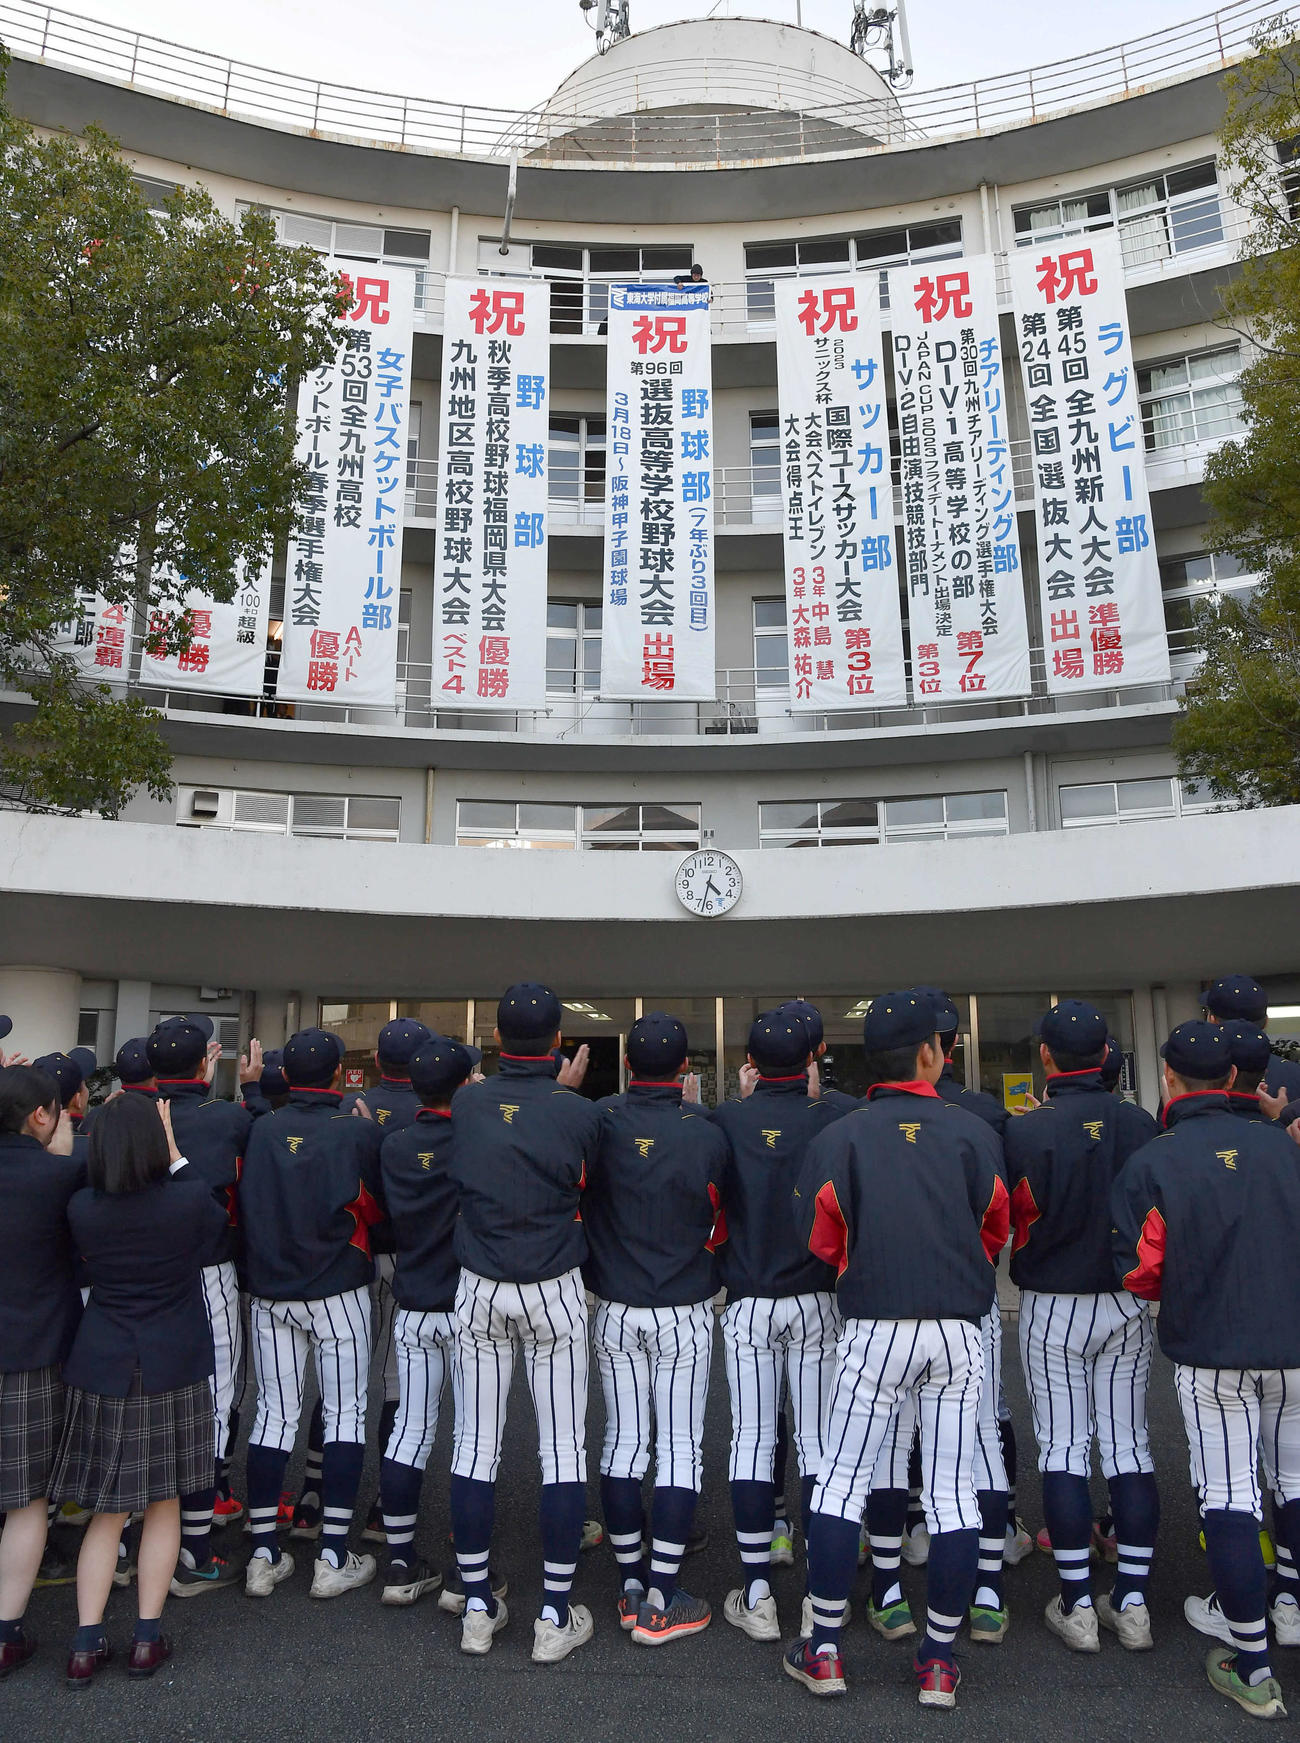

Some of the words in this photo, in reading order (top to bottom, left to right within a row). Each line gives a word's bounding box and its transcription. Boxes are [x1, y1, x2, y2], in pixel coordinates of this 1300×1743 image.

[334, 273, 390, 325] 祝
[914, 271, 973, 323] 祝
[1035, 248, 1098, 304] 祝
[468, 289, 526, 336] 祝
[631, 315, 688, 354] 祝
[798, 287, 858, 336] 祝
[630, 361, 684, 376] 第96回
[814, 337, 833, 405] サニックス杯
[833, 339, 845, 370] 2023
[333, 329, 373, 529] 第53回全九州高校
[681, 388, 711, 503] 野球部
[979, 337, 1018, 574] チアリーディング部
[1098, 322, 1150, 555] ラグビー部
[362, 347, 405, 631] 女子バスケットボール部
[441, 339, 477, 626] 九州地区高校野球大会
[481, 339, 512, 632] 秋季高校野球福岡県大会
[514, 374, 546, 549] 野球部
[784, 413, 805, 541] 大会得点王
[804, 412, 827, 561] 大会ベストイレブン
[851, 358, 892, 572] サッカー部
[639, 378, 675, 627] 選抜高等学校野球大会
[825, 406, 863, 623] 国際ユースサッカー大会
[844, 627, 874, 696] 第3位
[94, 604, 126, 668] 4連覇
[307, 629, 341, 692] 優勝
[343, 626, 362, 682] Aパート
[442, 633, 468, 694] ベスト4
[477, 635, 511, 698] 優勝
[641, 632, 675, 691] 出場
[956, 630, 987, 693] 第7位
[1050, 609, 1085, 680] 出場
[1088, 602, 1124, 676] 準優勝
[917, 643, 942, 694] 第3位
[682, 880, 689, 889] 9
[685, 868, 695, 878] 10
[704, 856, 714, 866] 12
[725, 866, 732, 876] 2
[728, 878, 736, 887] 3
[686, 891, 694, 900] 8
[696, 898, 702, 908] 7
[706, 901, 713, 910] 6
[725, 889, 732, 898] 4
